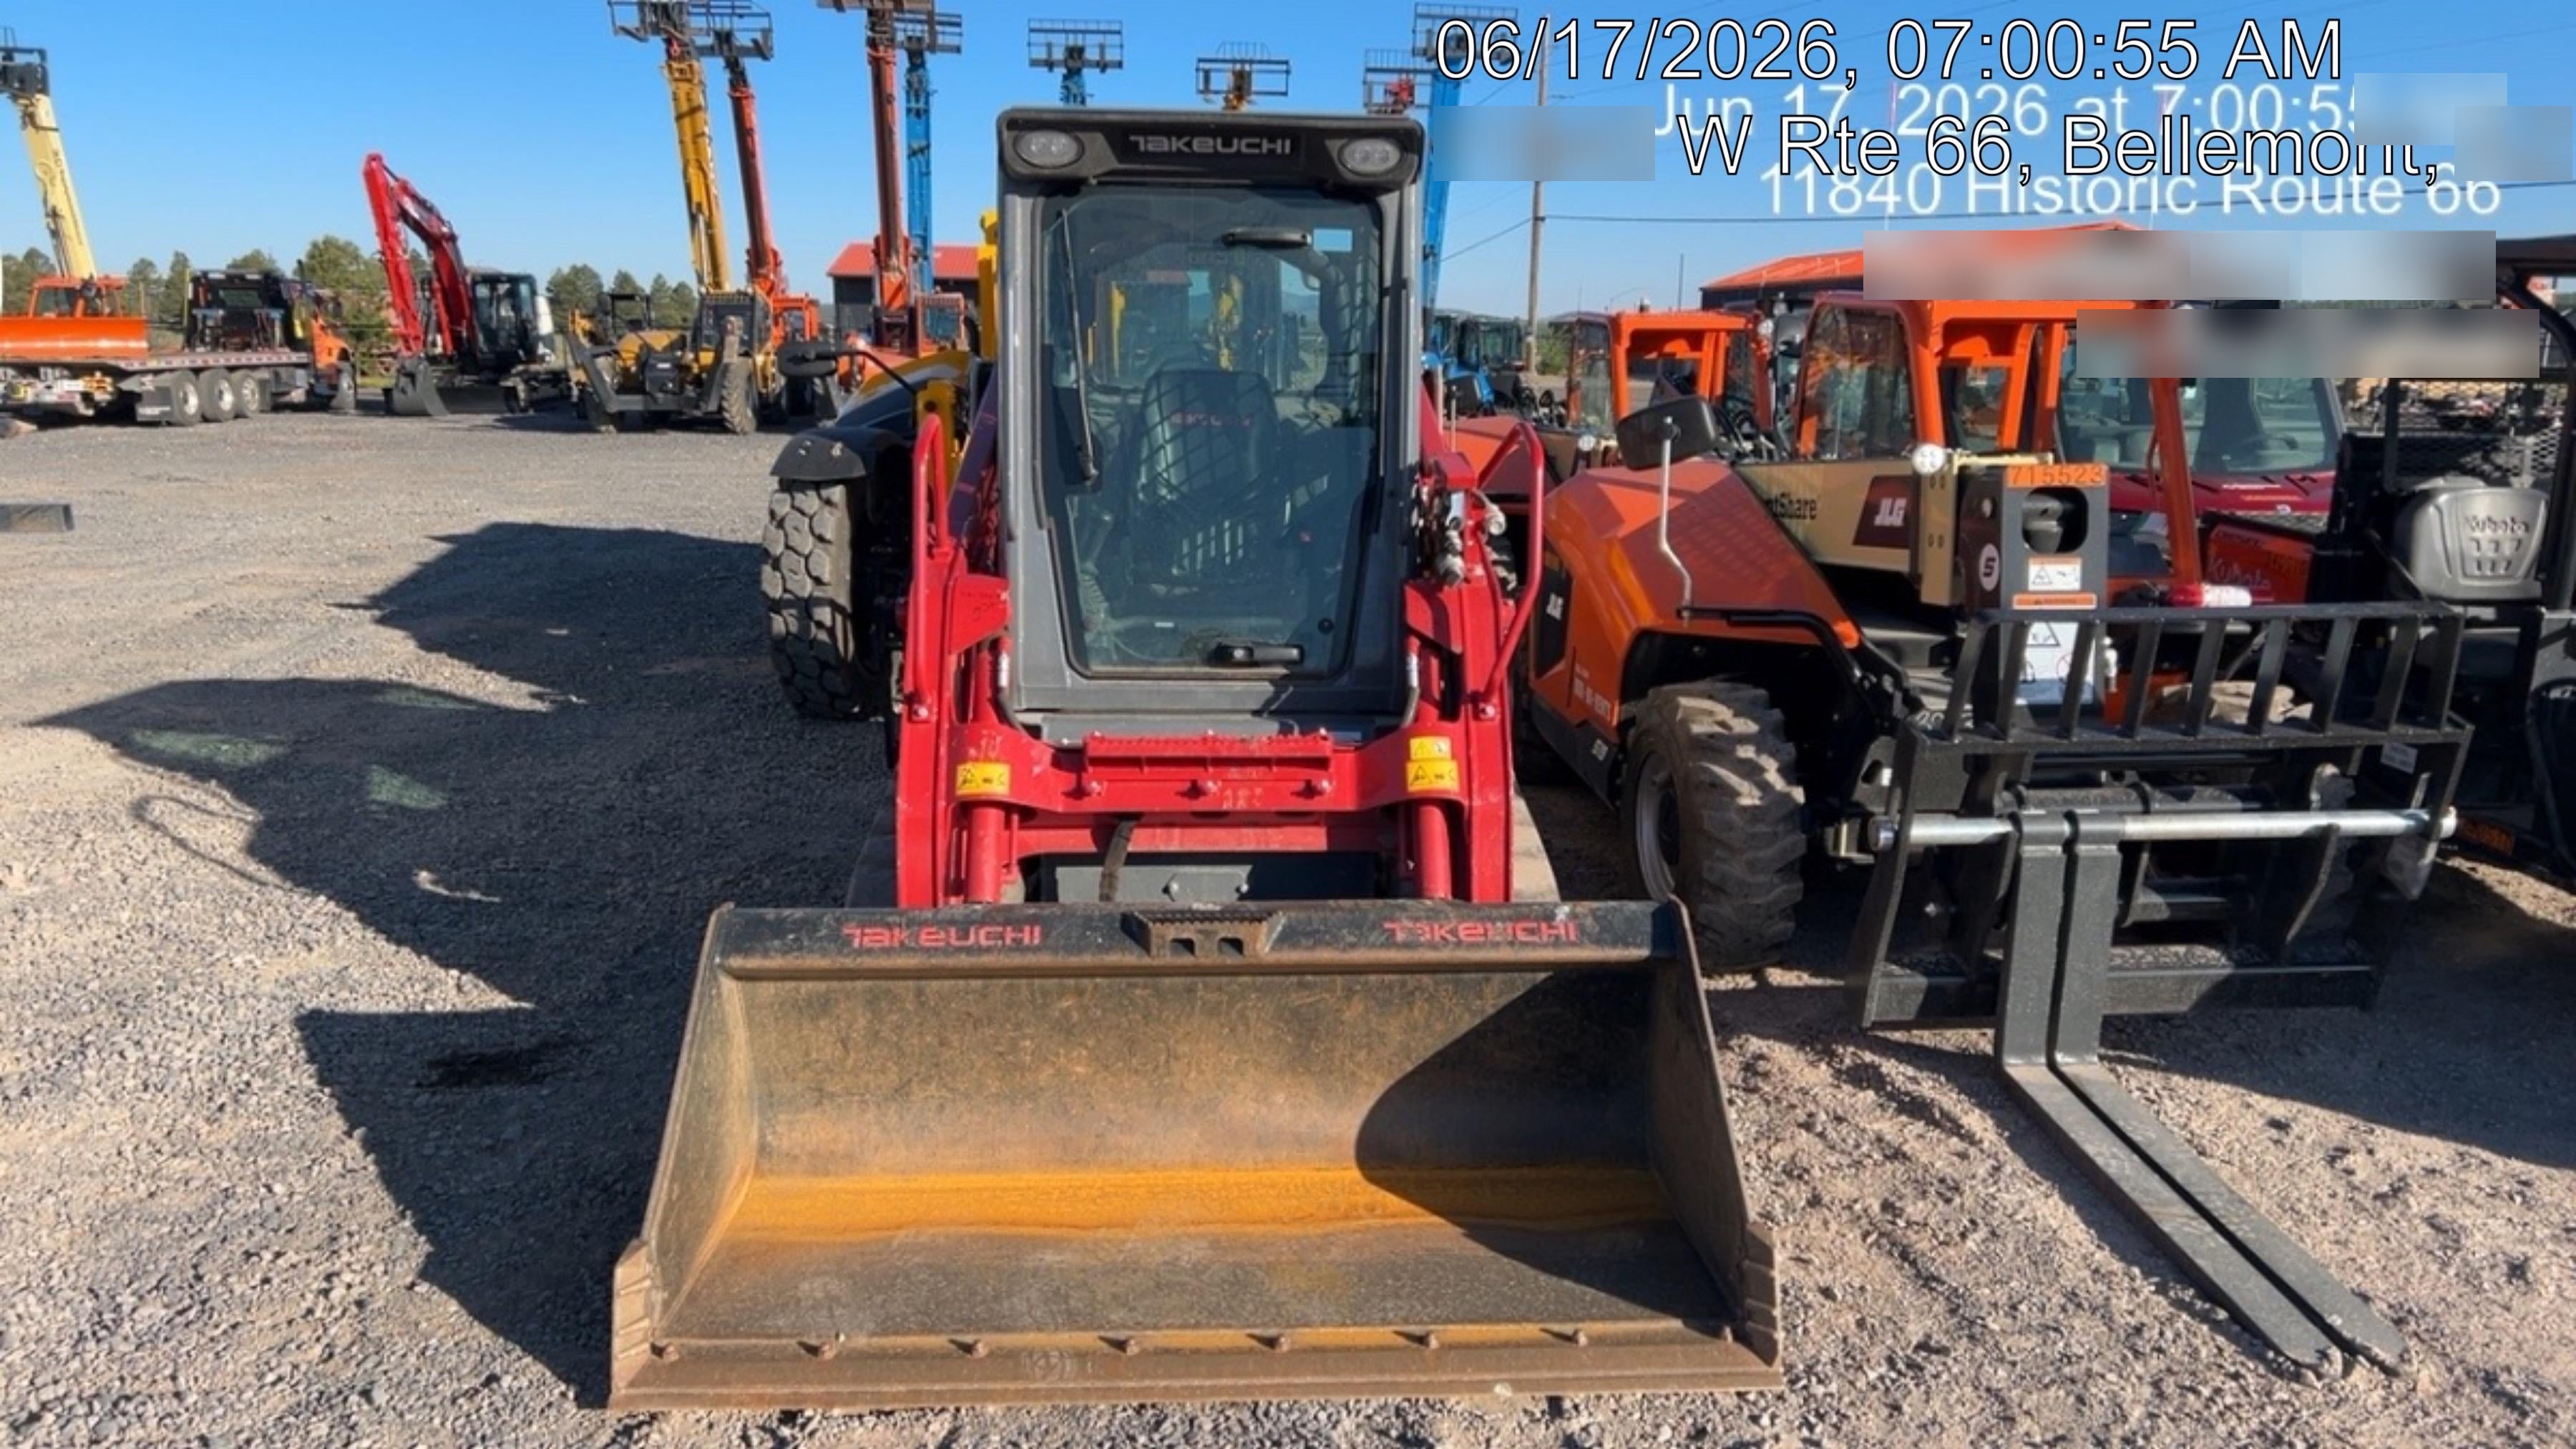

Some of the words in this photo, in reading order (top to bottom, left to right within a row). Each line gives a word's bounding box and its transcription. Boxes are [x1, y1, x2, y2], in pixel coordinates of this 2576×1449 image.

[1128, 134, 1292, 155] TAKEUCHI
[1873, 497, 1907, 527] JLG
[843, 923, 1041, 948] TAKEUCHI
